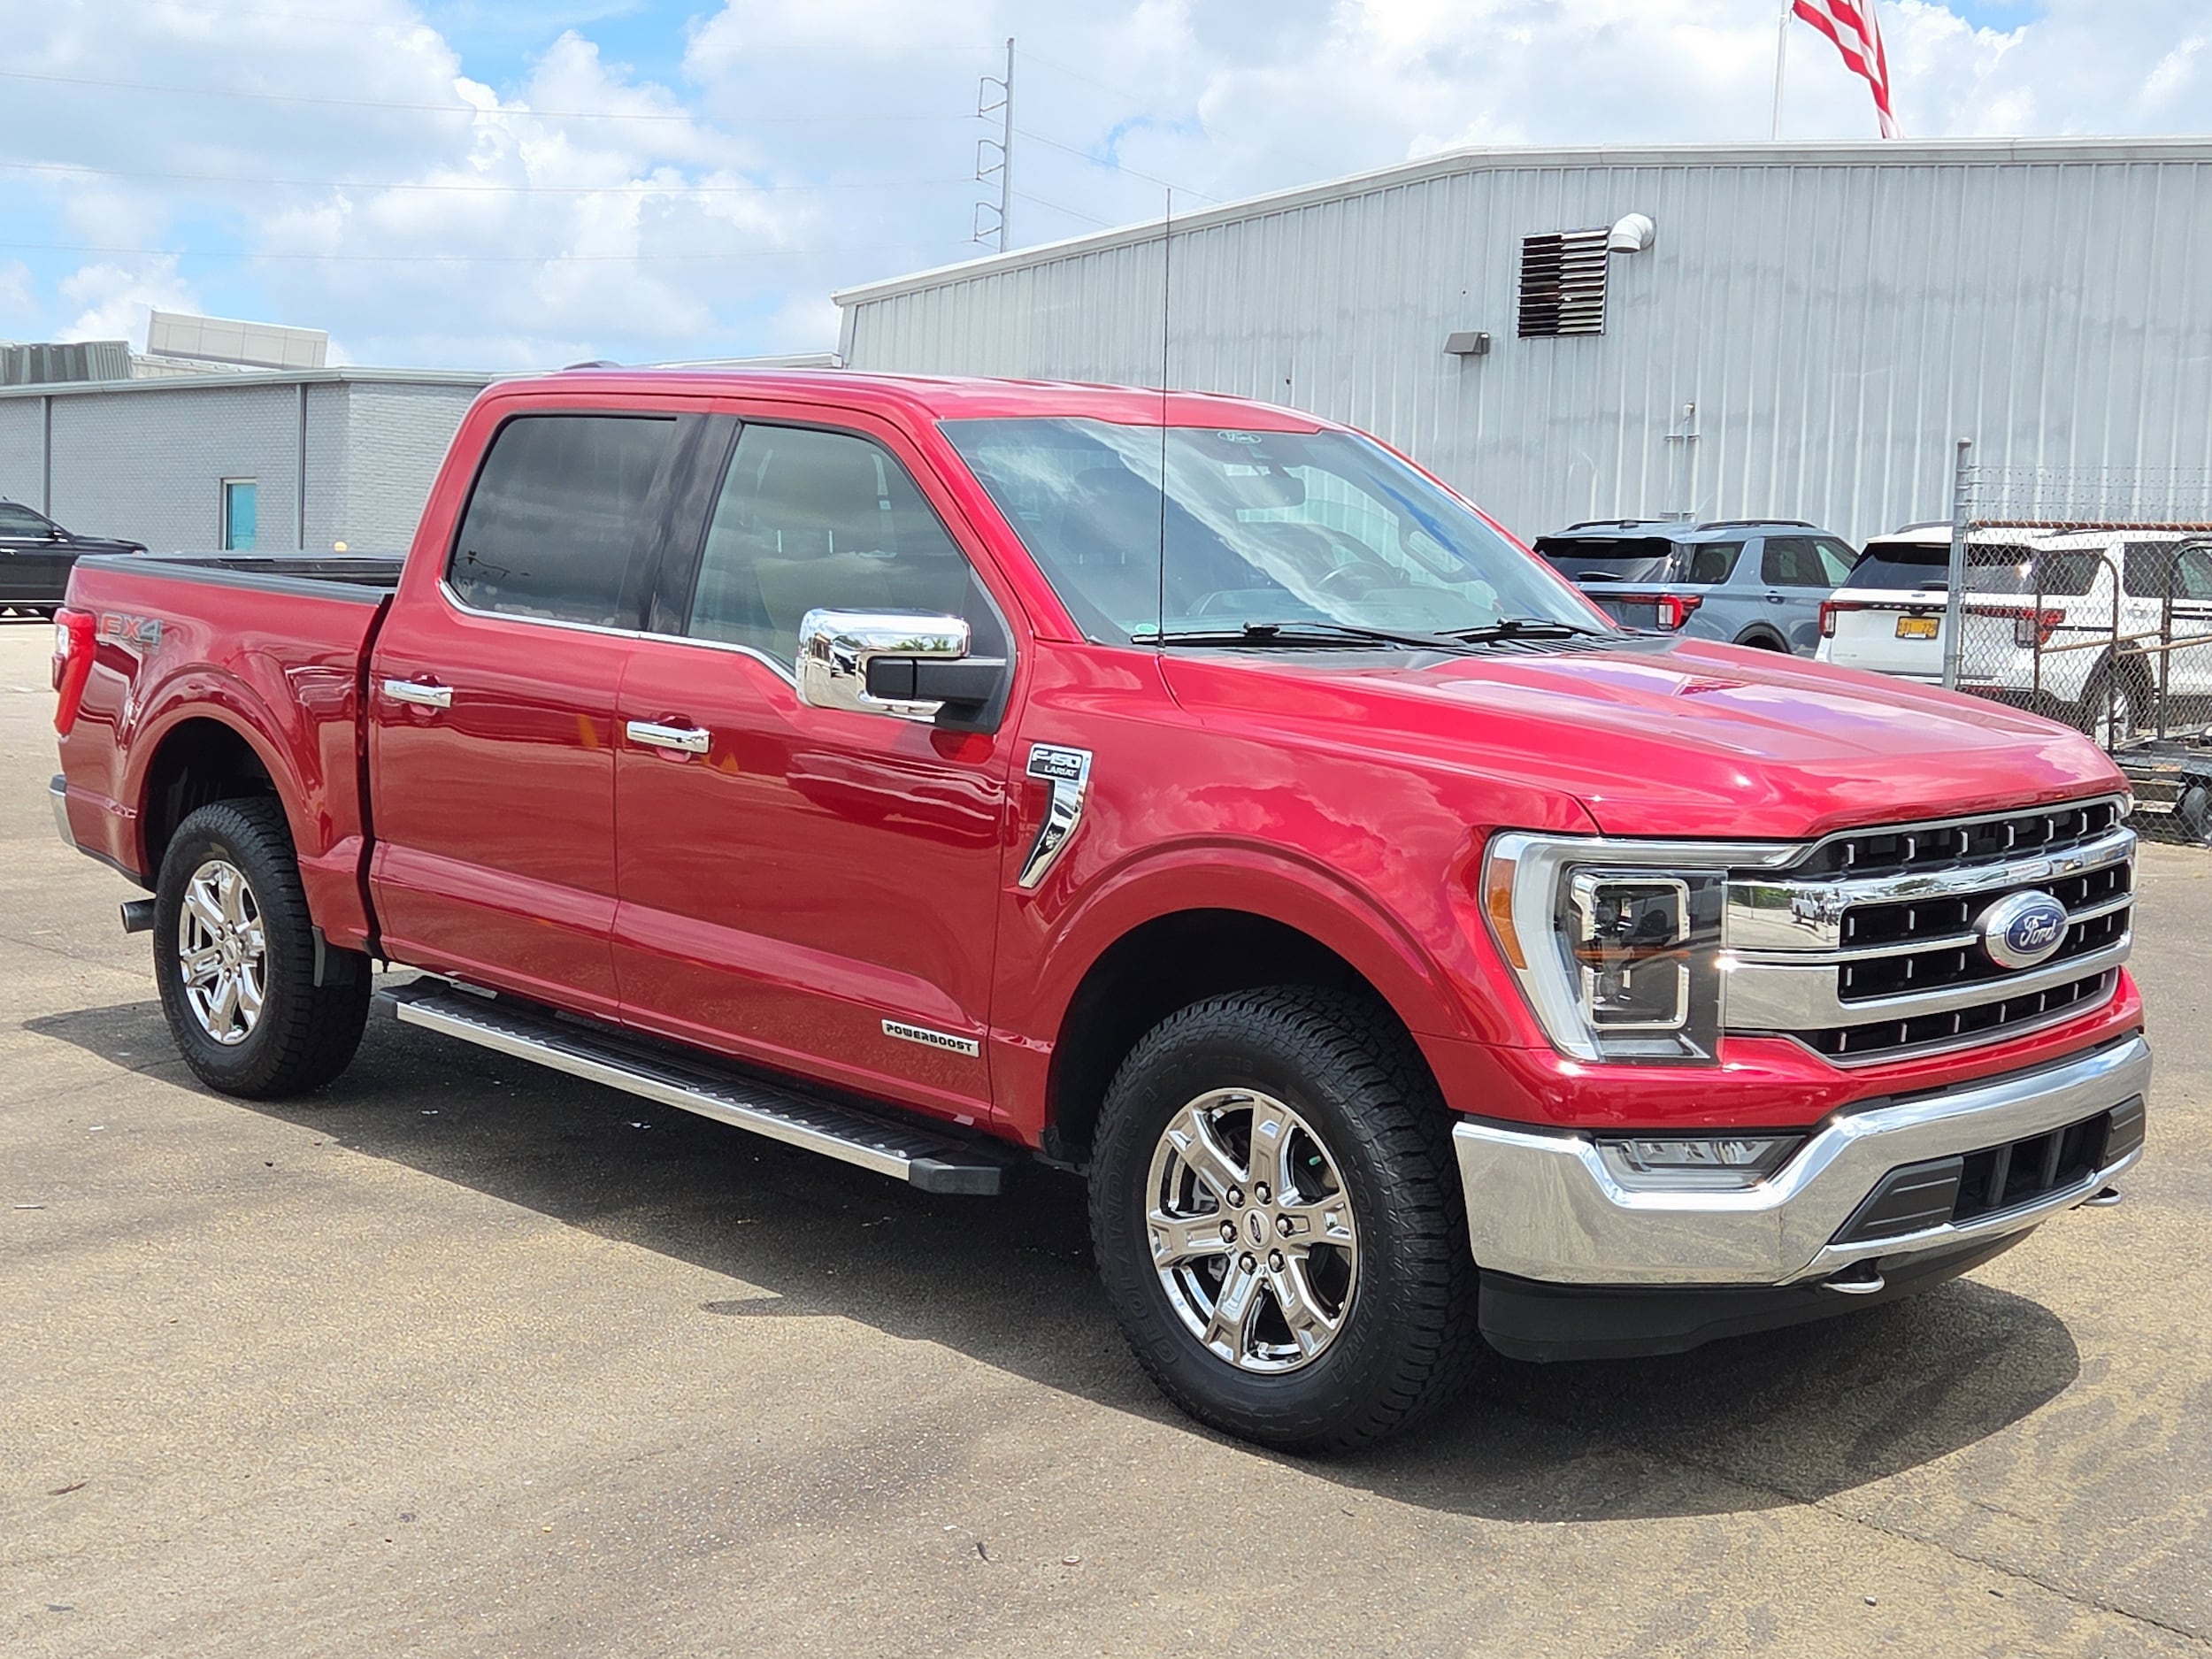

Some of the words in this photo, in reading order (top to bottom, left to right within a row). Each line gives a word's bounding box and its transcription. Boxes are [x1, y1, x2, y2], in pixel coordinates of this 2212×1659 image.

[1032, 749, 1082, 769] F-150
[1044, 764, 1078, 777] LARIAT
[2019, 913, 2057, 947] Ford
[885, 1023, 972, 1052] POWERBOOST
